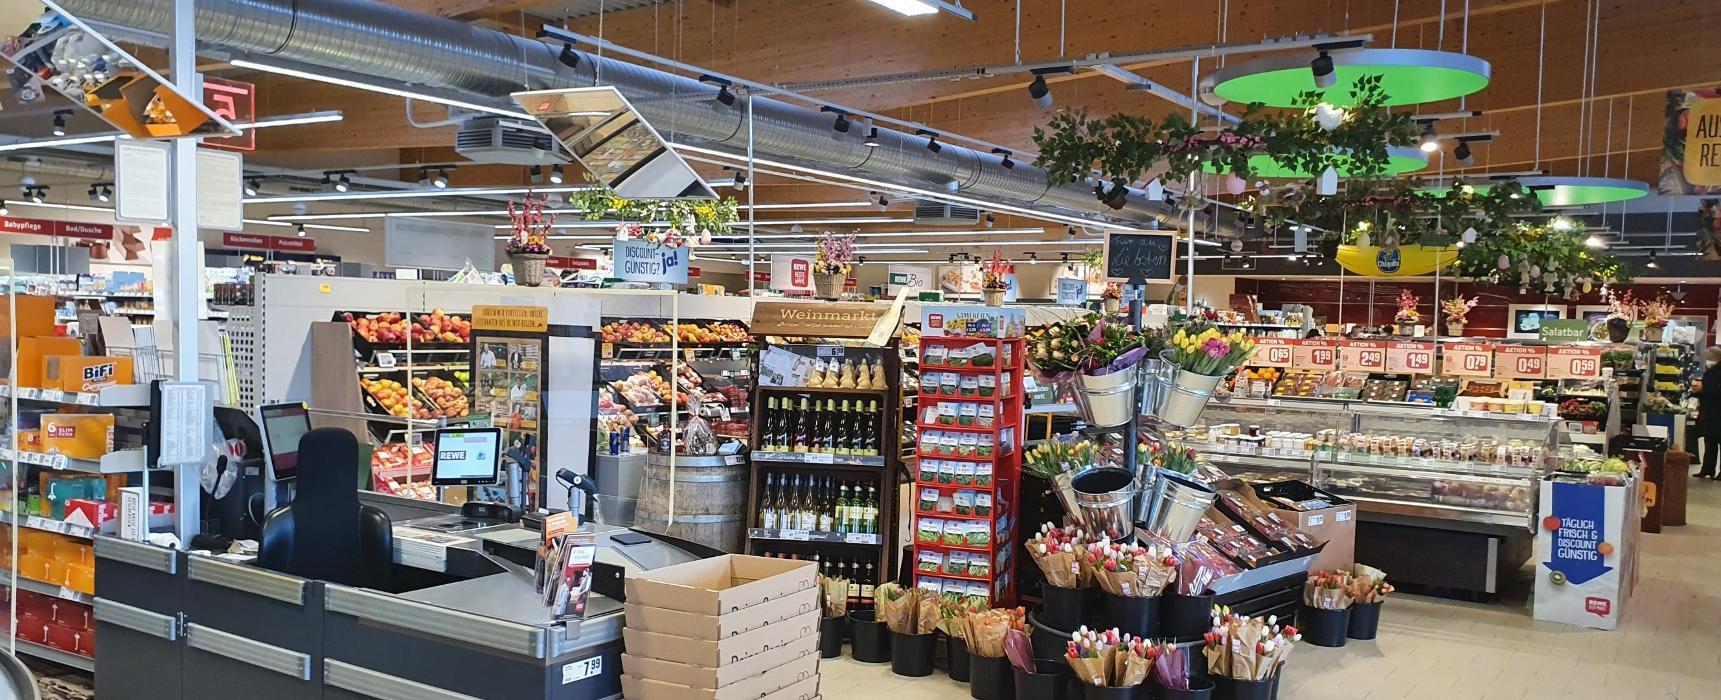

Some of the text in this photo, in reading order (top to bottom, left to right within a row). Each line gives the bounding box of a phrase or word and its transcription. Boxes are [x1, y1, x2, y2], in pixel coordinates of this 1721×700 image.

[1695, 113, 1721, 138] AU
[4, 220, 42, 231] Babypflege
[65, 224, 102, 234] Bad/Dusche
[625, 246, 659, 260] DISCOUNT-
[624, 259, 660, 275] GÜNSTIG?
[661, 250, 678, 276] ja!
[793, 263, 807, 271] REWE
[907, 273, 923, 287] Bio
[780, 308, 878, 321] Weinmarkt
[1541, 326, 1584, 337] Salatbar
[1270, 348, 1289, 362] 0.65
[1313, 350, 1331, 364] 1.99
[1361, 352, 1381, 365] 2.49
[1408, 353, 1428, 367] 1.49
[1466, 355, 1486, 370] 0.79
[1518, 358, 1540, 373] 0.49
[1572, 359, 1594, 375] 0.59
[47, 422, 57, 433] 6
[27, 433, 34, 442] 8
[440, 451, 466, 460] REWE
[1561, 518, 1594, 530] TÄGLICH
[1558, 528, 1598, 540] FRISCH &
[1558, 538, 1597, 550] DISCOUNT
[1557, 547, 1598, 561] GÜNSTIG
[583, 658, 601, 676] 7.99
